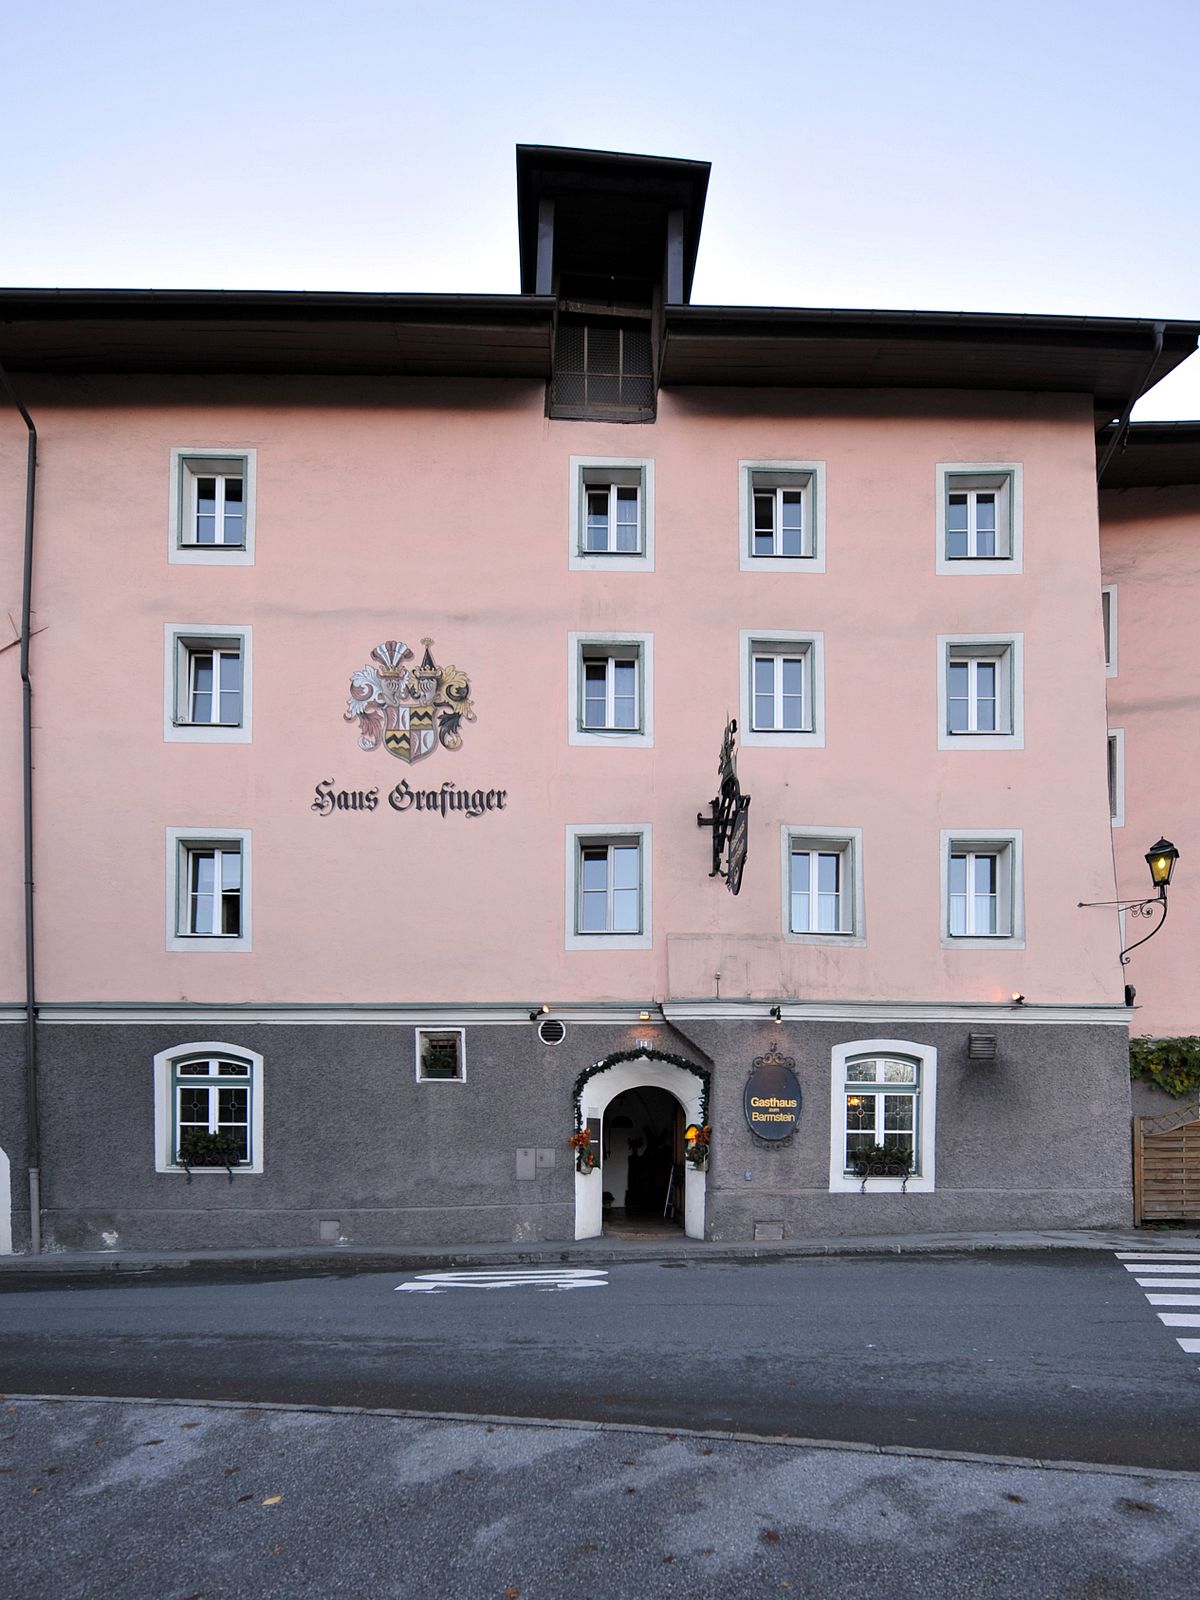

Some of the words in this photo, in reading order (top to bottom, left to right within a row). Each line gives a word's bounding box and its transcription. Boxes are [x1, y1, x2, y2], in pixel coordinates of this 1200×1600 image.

[311, 777, 379, 817] Haus
[751, 1097, 798, 1107] Gasthaus
[752, 1112, 796, 1122] Barmstein
